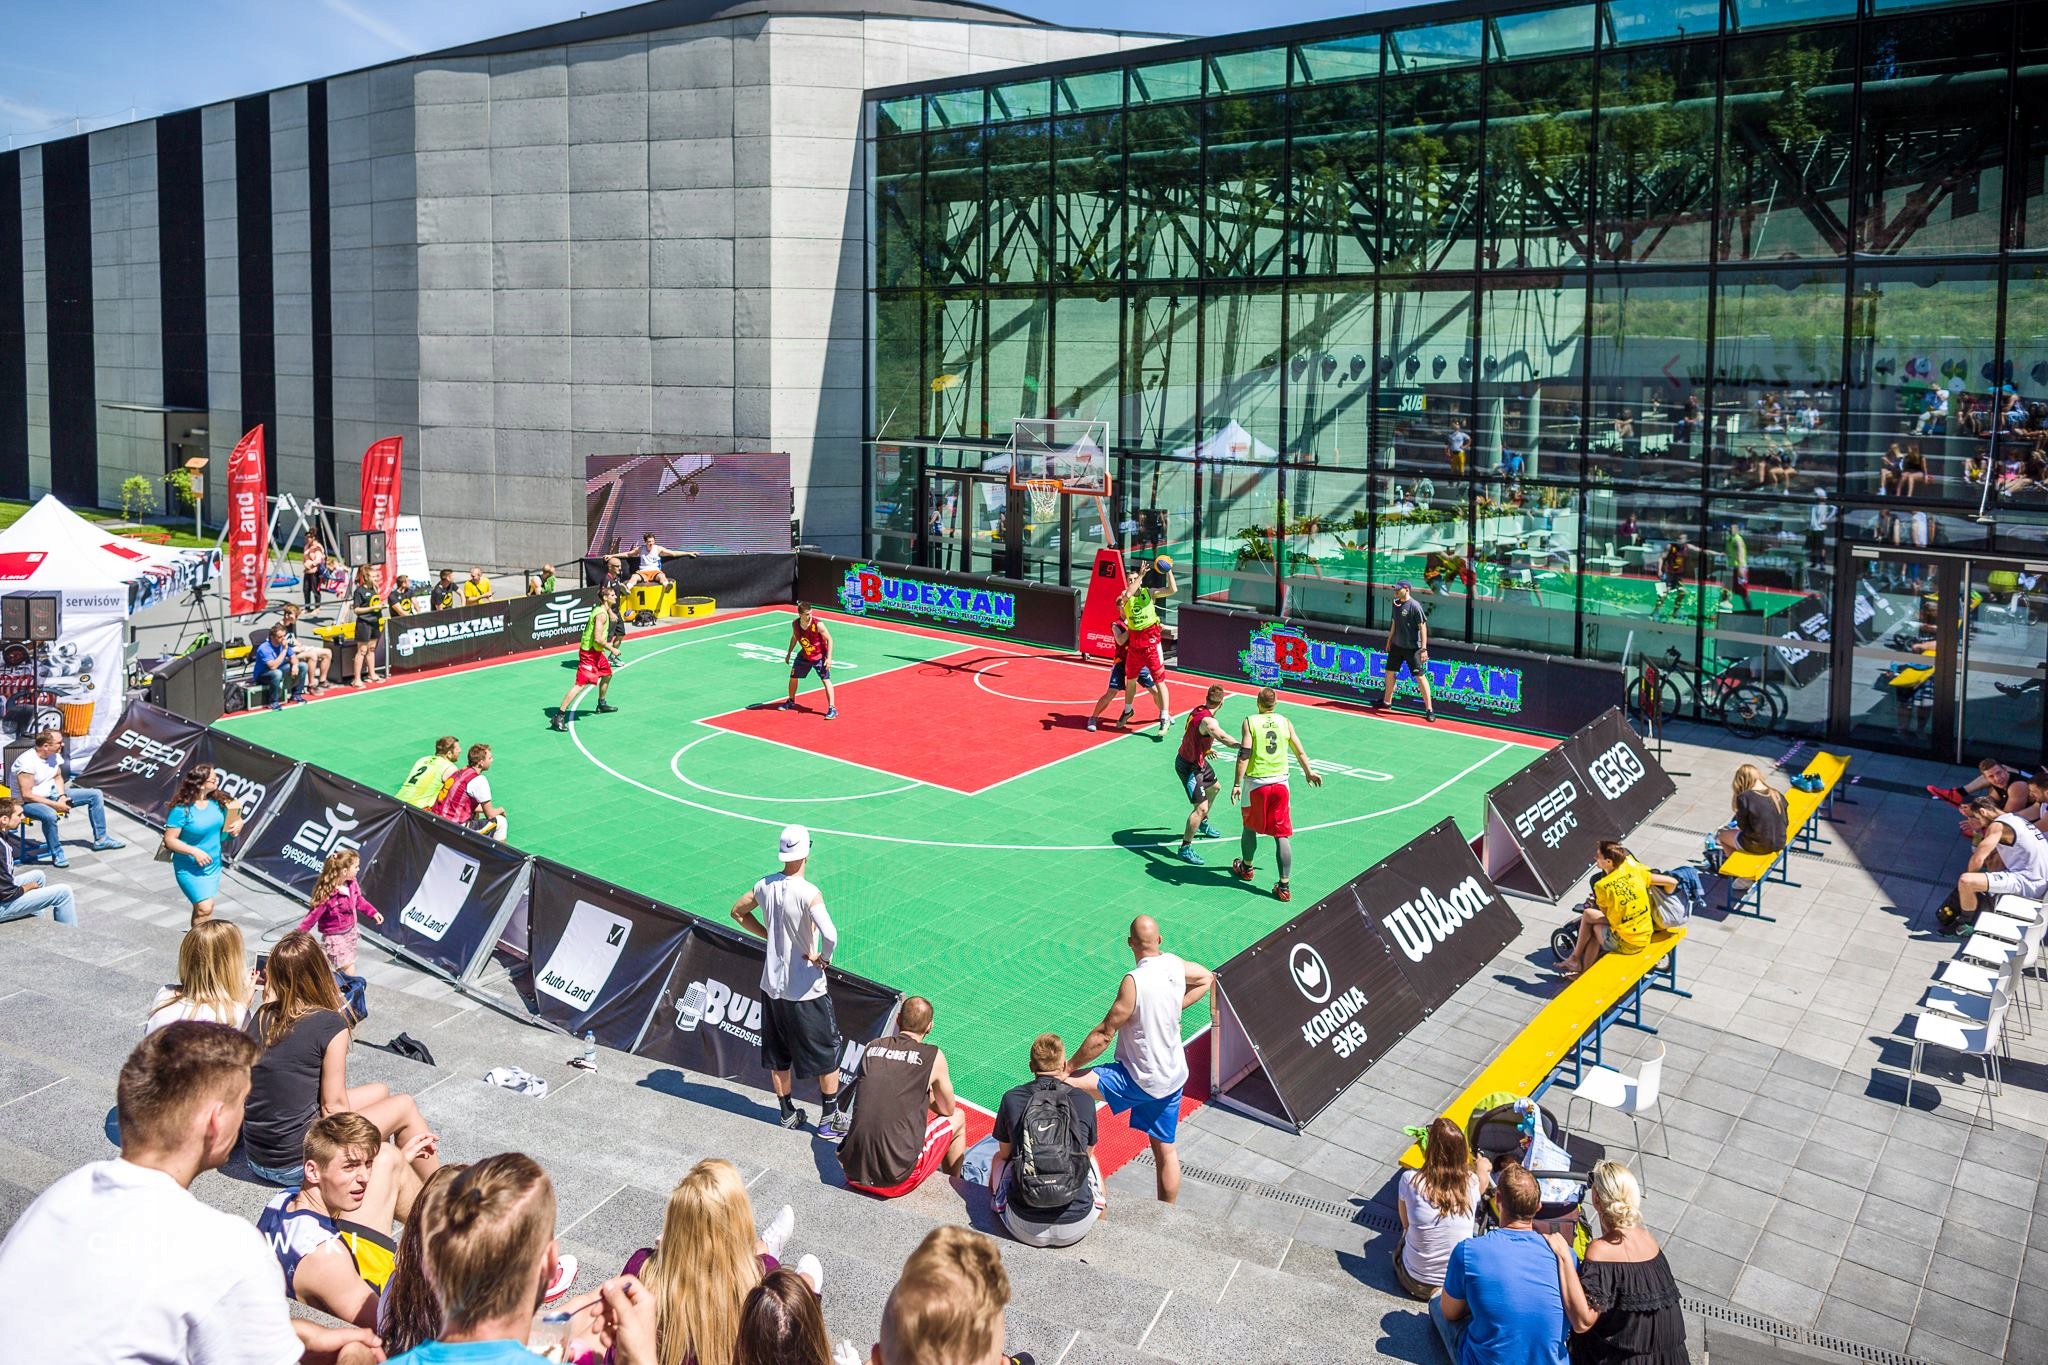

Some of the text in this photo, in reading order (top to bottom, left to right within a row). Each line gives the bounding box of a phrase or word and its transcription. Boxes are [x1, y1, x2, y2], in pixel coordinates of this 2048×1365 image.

[236, 491, 258, 604] Auto Land
[66, 595, 120, 607] serwisów
[636, 590, 646, 606] 1
[687, 606, 695, 615] 3
[859, 571, 1014, 617] BUDEXTAN
[407, 615, 505, 649] BUDEXTAN
[115, 729, 187, 768] SPEED
[1265, 730, 1277, 754] 3
[117, 755, 161, 779] sport
[408, 765, 428, 785] 2
[1515, 780, 1578, 839] SPEED
[1541, 810, 1578, 849] sport
[405, 906, 447, 933] Auto Land
[1381, 875, 1494, 963] Wilson
[541, 970, 595, 1002] Auto Land
[1301, 985, 1369, 1048] KORONA
